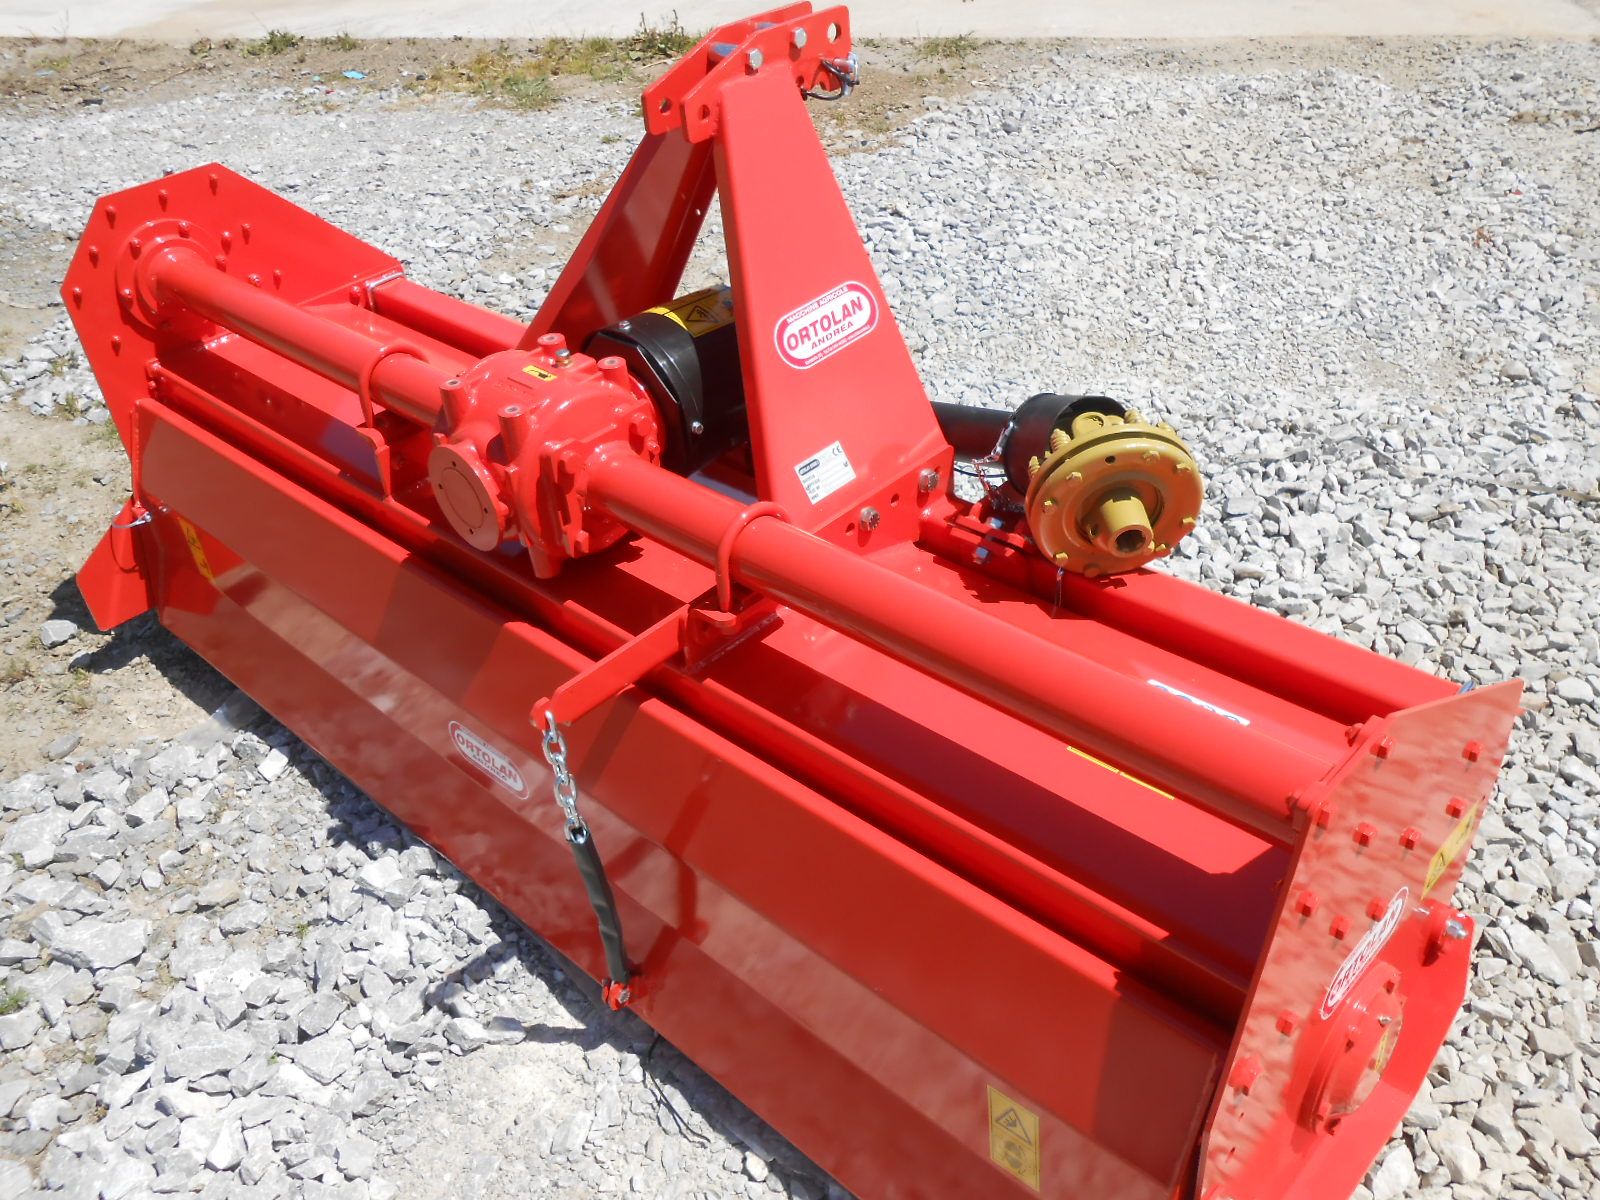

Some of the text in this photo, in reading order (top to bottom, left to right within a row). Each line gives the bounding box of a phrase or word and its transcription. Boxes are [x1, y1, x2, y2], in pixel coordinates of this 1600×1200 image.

[820, 285, 849, 307] AGRICOLE
[787, 296, 863, 351] ORTOLAN
[811, 321, 854, 350] ANDREA
[456, 733, 518, 783] ORTOLAN
